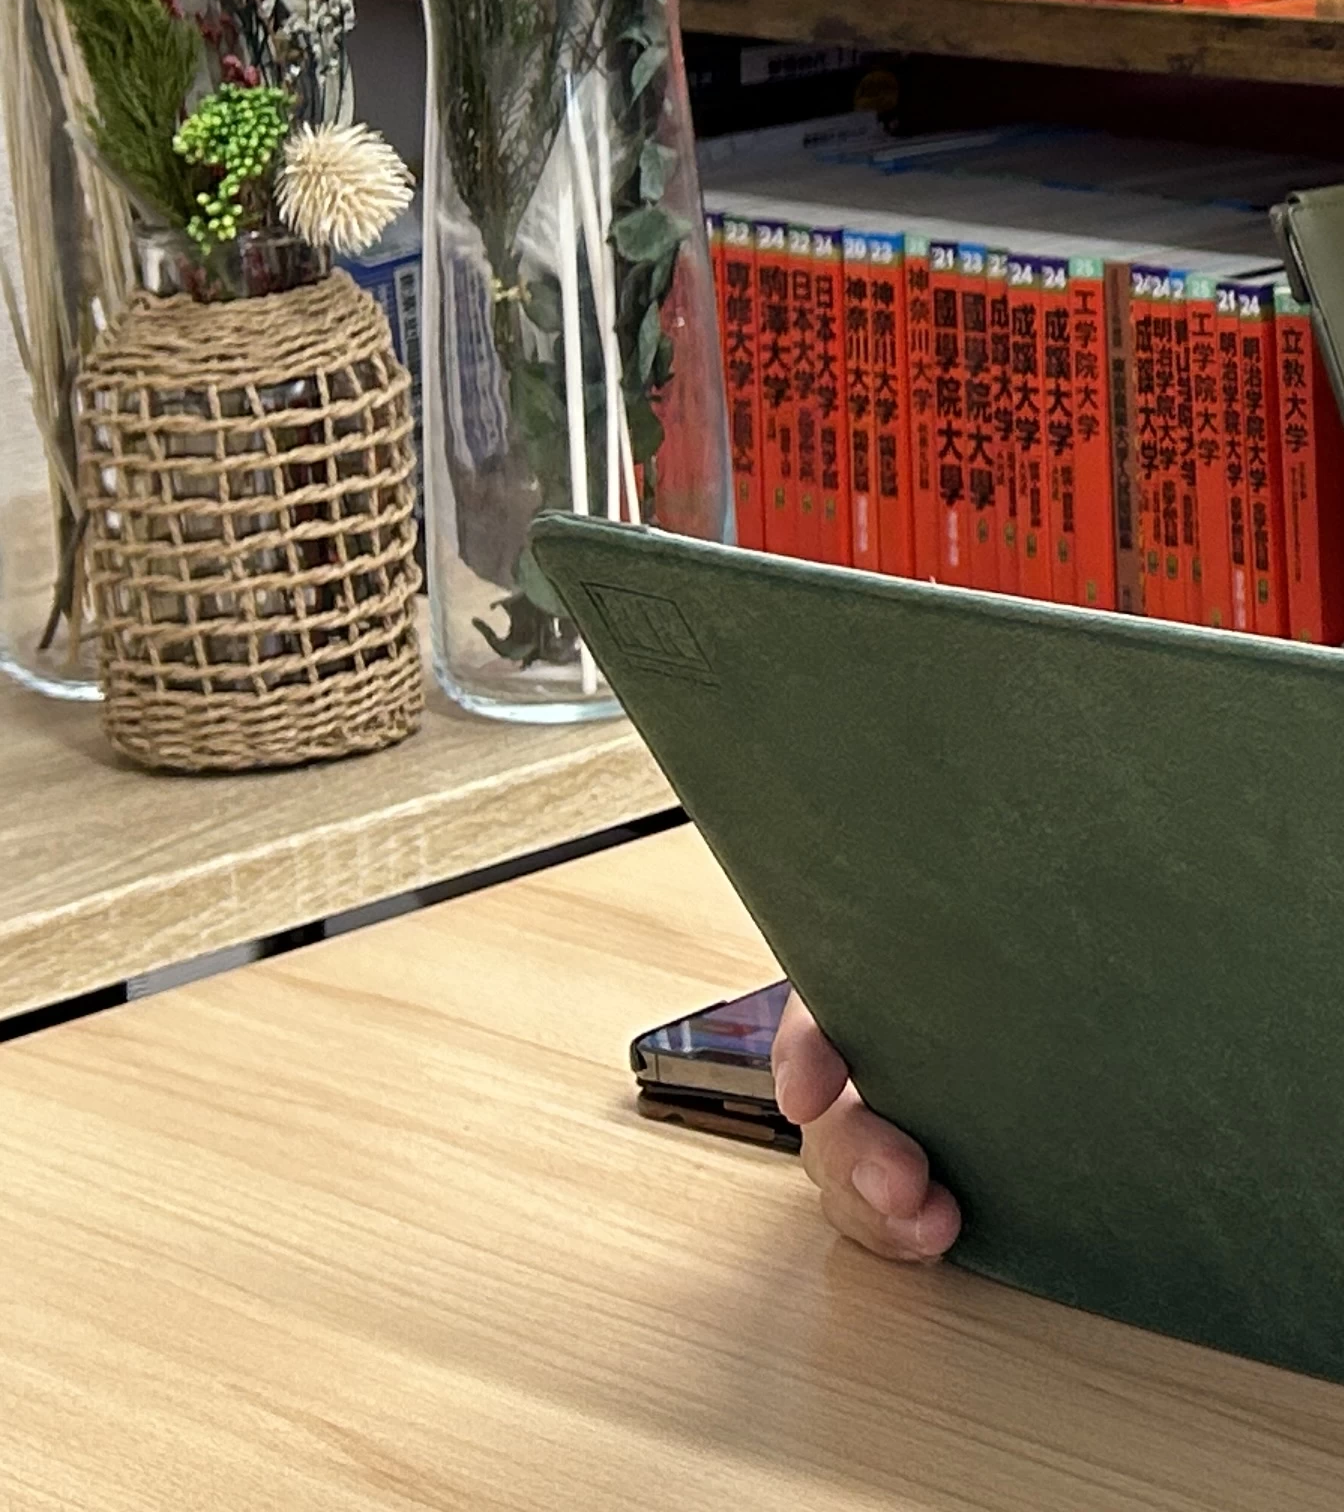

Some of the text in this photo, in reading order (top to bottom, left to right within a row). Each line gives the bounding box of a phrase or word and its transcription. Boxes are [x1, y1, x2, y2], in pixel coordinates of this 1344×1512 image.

[792, 269, 815, 399] 日本大学
[816, 275, 838, 419] 日本大学
[1075, 290, 1099, 440] 工学院大学
[1192, 311, 1221, 466] 工学院大学
[1281, 326, 1309, 453] 立教大学
